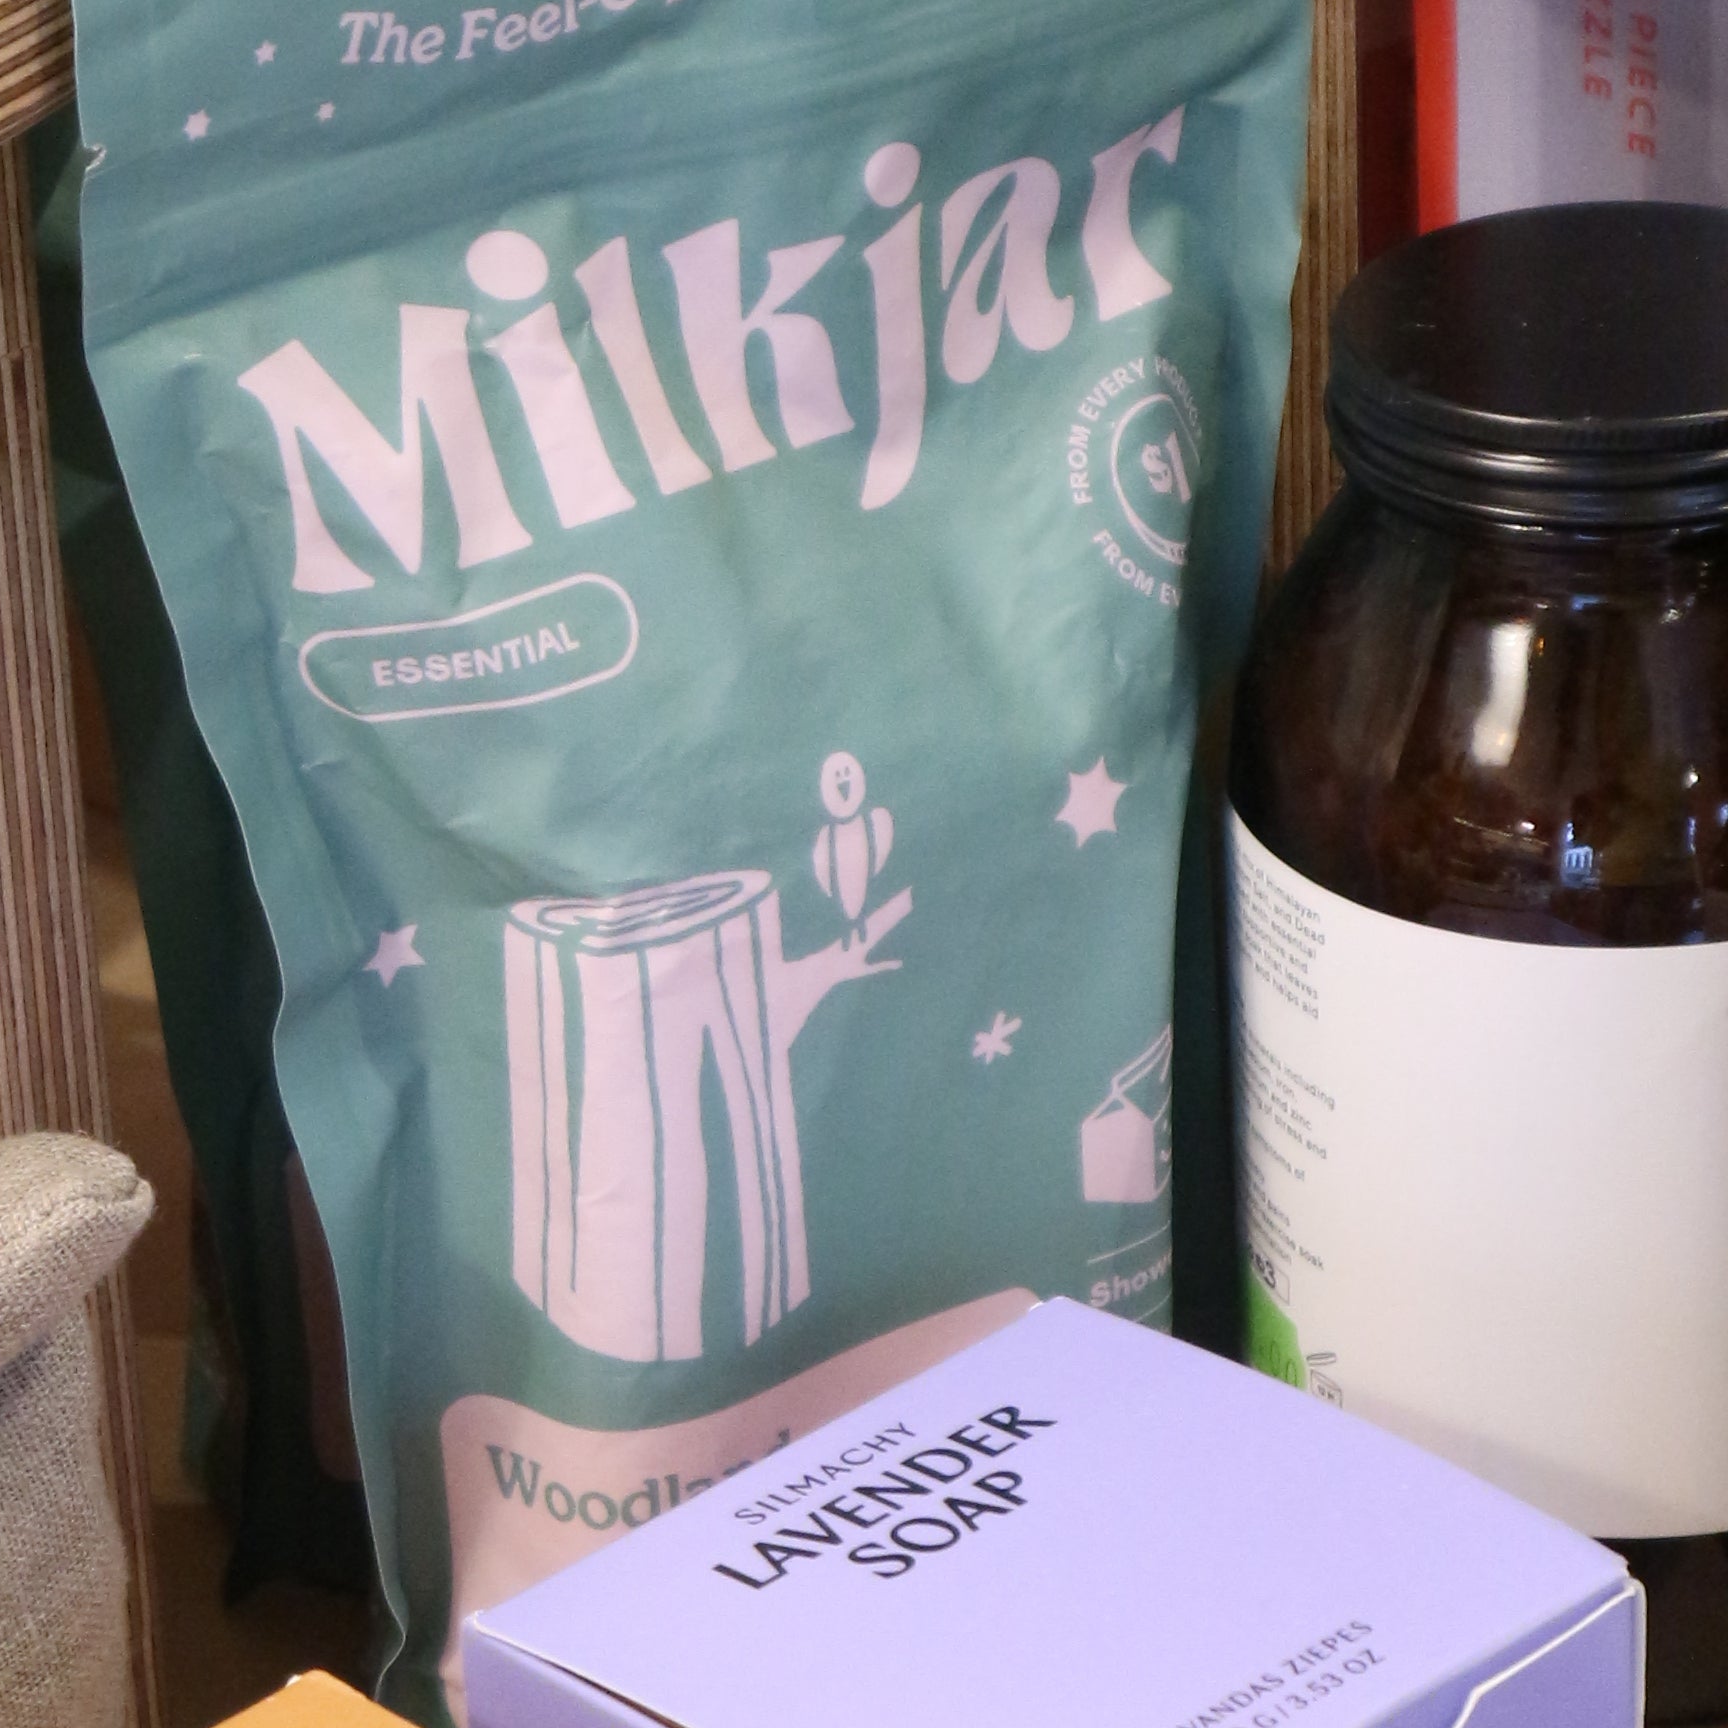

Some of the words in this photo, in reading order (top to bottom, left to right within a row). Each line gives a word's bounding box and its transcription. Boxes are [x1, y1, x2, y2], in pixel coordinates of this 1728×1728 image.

[338, 10, 446, 65] The
[1627, 12, 1658, 160] PIECE
[237, 104, 1187, 595] Milkjar
[1077, 357, 1146, 422] EVERY
[1067, 424, 1093, 505] FROM
[1093, 528, 1155, 597] FROM
[371, 620, 581, 690] ESSENTIAL
[486, 1428, 791, 1531] Woodl
[712, 1405, 1058, 1590] LAVENDER
[734, 1421, 918, 1525] SILMACHY
[847, 1470, 1029, 1579] SOAP
[1283, 1620, 1373, 1676] ZIEPES
